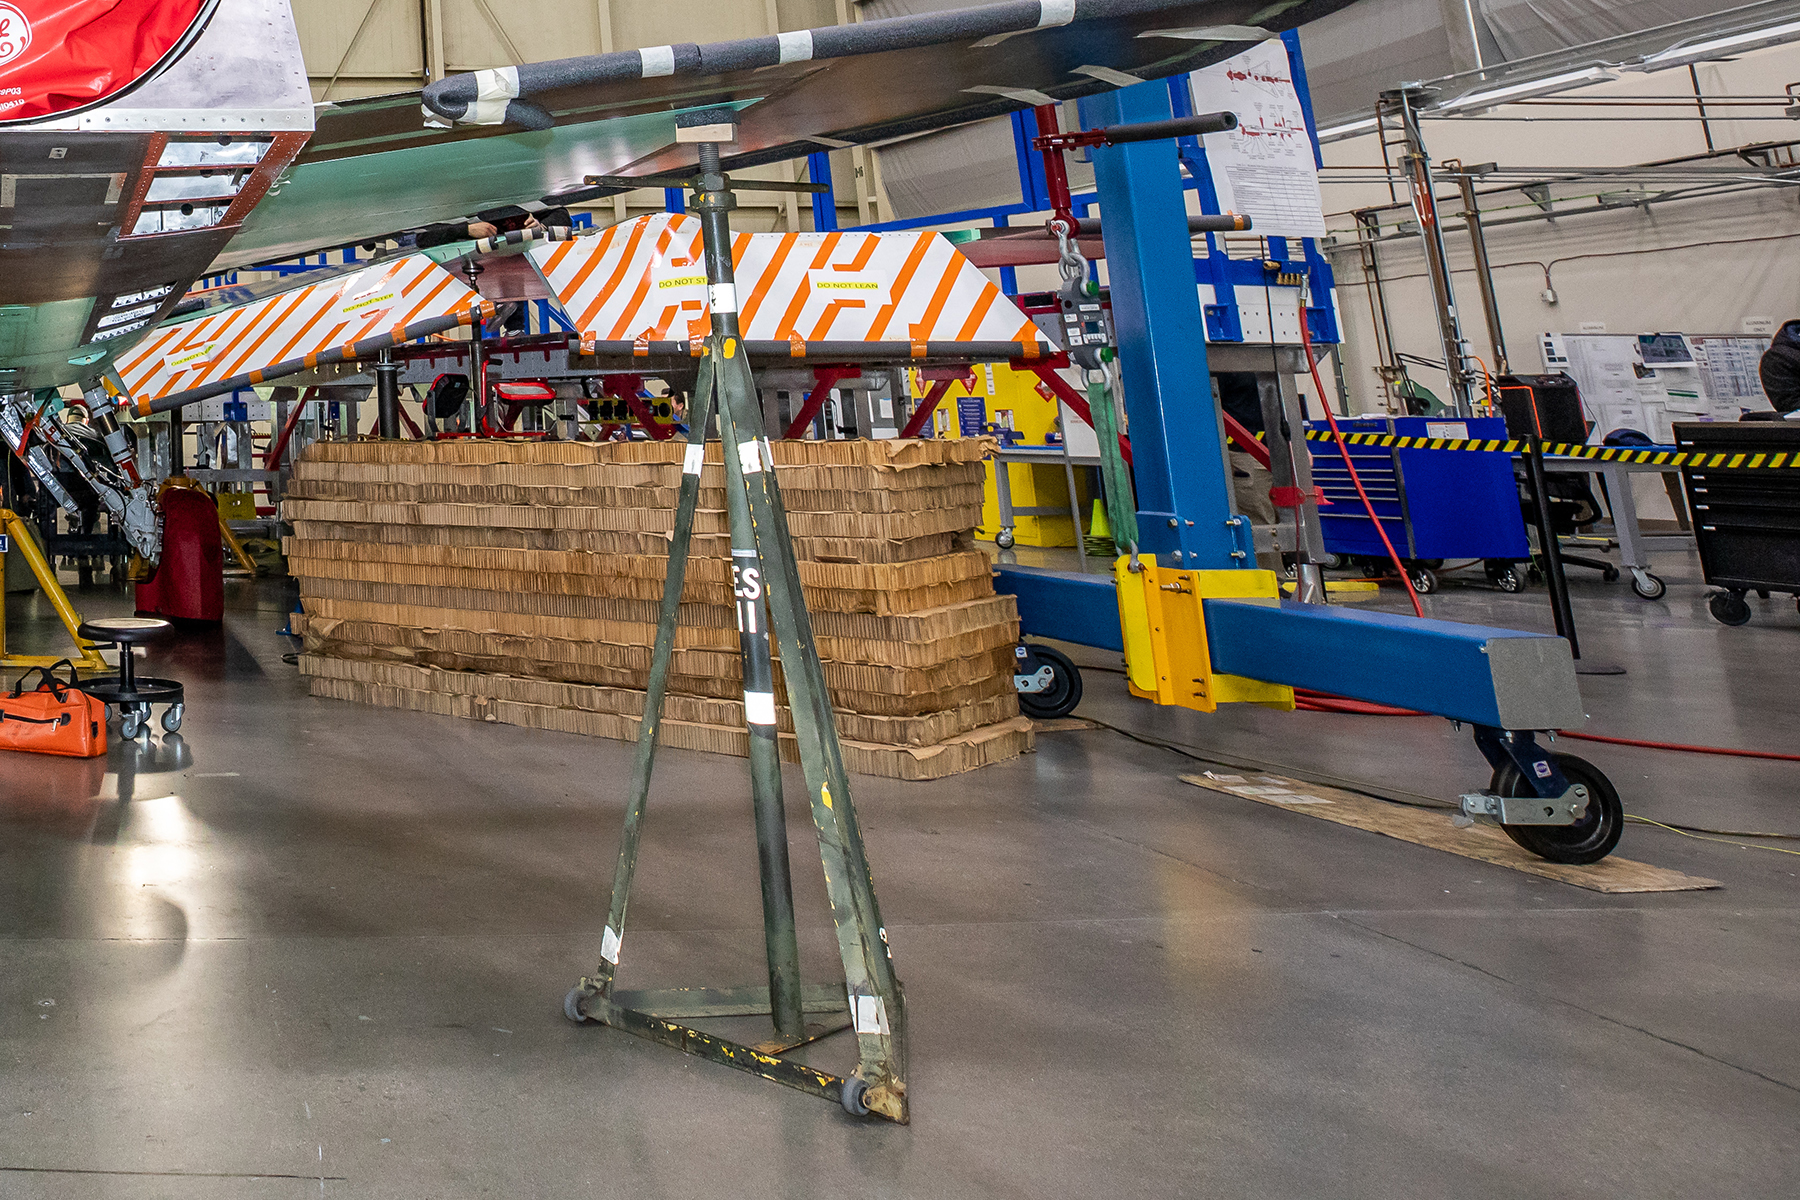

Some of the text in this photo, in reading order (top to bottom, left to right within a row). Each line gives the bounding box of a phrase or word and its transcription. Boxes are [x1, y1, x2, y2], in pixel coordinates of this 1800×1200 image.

[658, 281, 672, 289] DO
[674, 277, 694, 286] NOT
[357, 299, 372, 308] NOT
[374, 293, 394, 302] STEP
